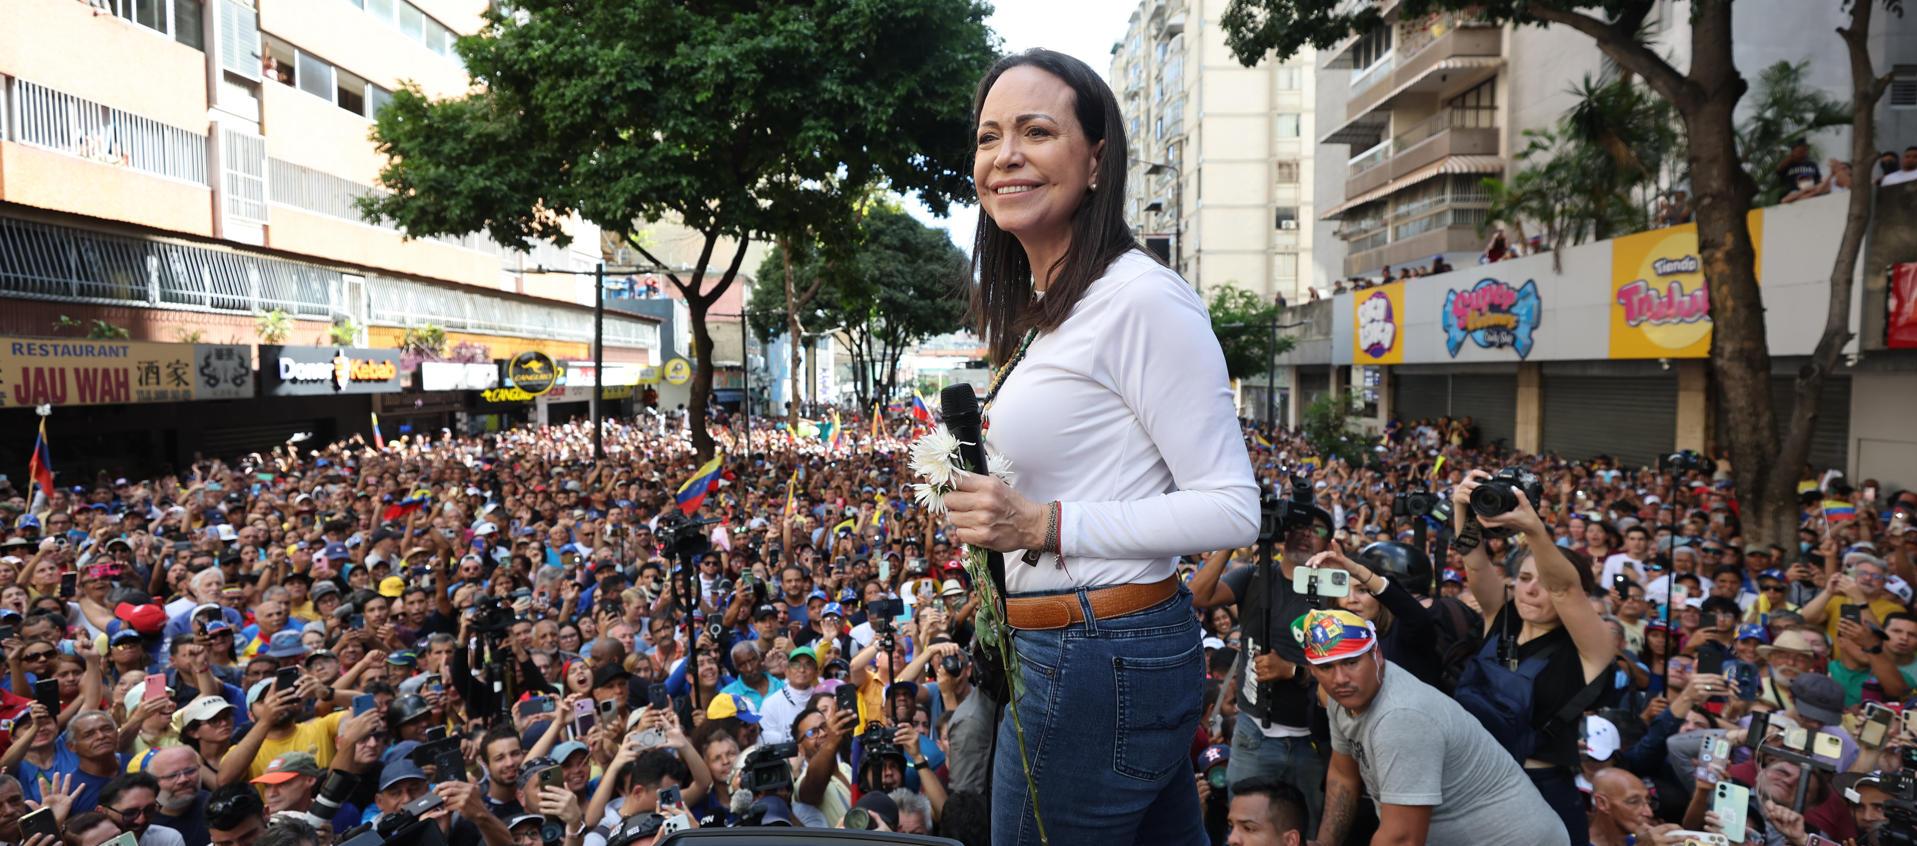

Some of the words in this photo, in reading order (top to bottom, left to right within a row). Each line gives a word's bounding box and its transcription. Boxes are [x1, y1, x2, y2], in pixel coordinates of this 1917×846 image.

[1654, 257, 1697, 274] Tienda
[1617, 280, 1710, 326] Trulul
[11, 342, 129, 357] RESTAURANT
[137, 359, 190, 387] 酒家
[351, 359, 397, 380] Kebab
[14, 366, 67, 405] JAU
[74, 367, 130, 403] WAH
